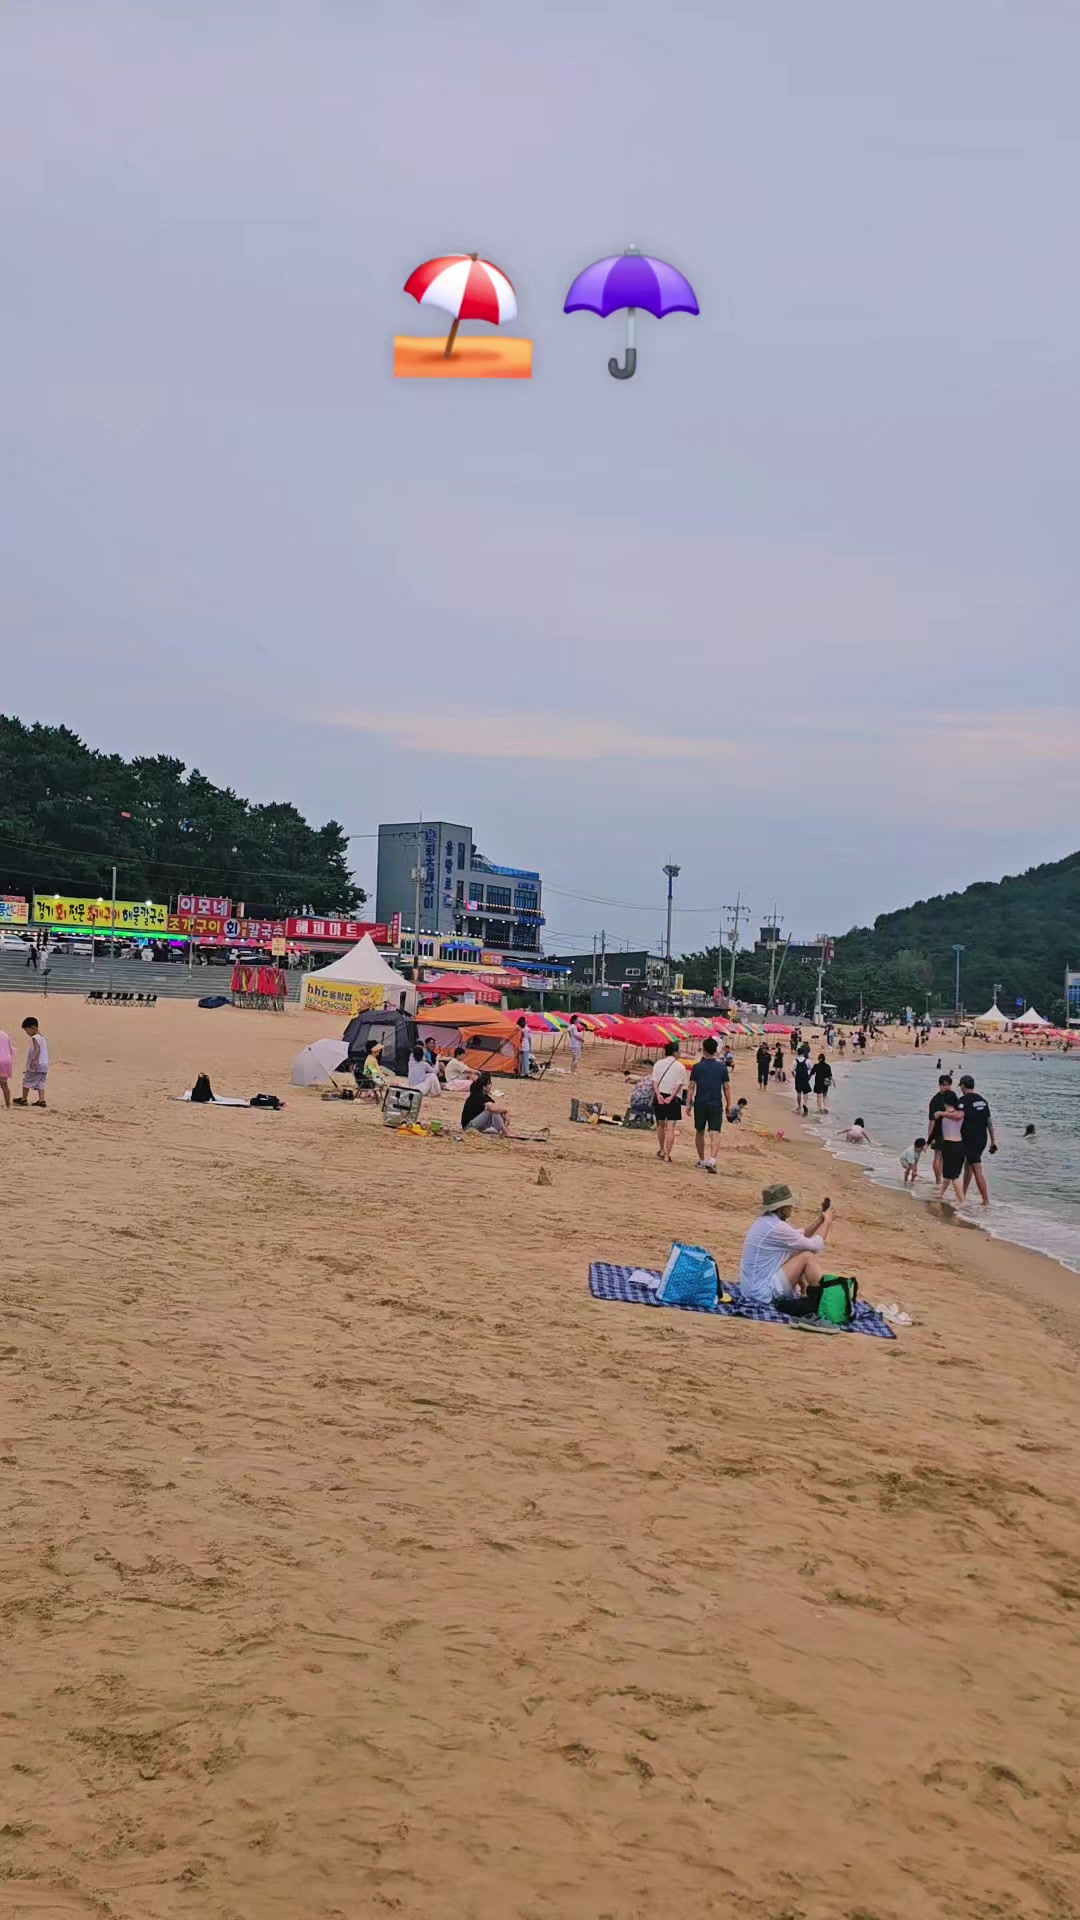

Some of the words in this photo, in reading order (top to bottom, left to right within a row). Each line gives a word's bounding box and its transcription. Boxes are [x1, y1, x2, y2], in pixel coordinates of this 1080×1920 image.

[36, 901, 54, 920] 경기
[55, 904, 66, 920] 회
[69, 904, 85, 922] 전문
[122, 905, 165, 927] 해물칼국수
[180, 897, 228, 916] 이모네
[168, 917, 220, 934] 조개구이
[226, 920, 238, 935] 회
[307, 983, 328, 998] bhc
